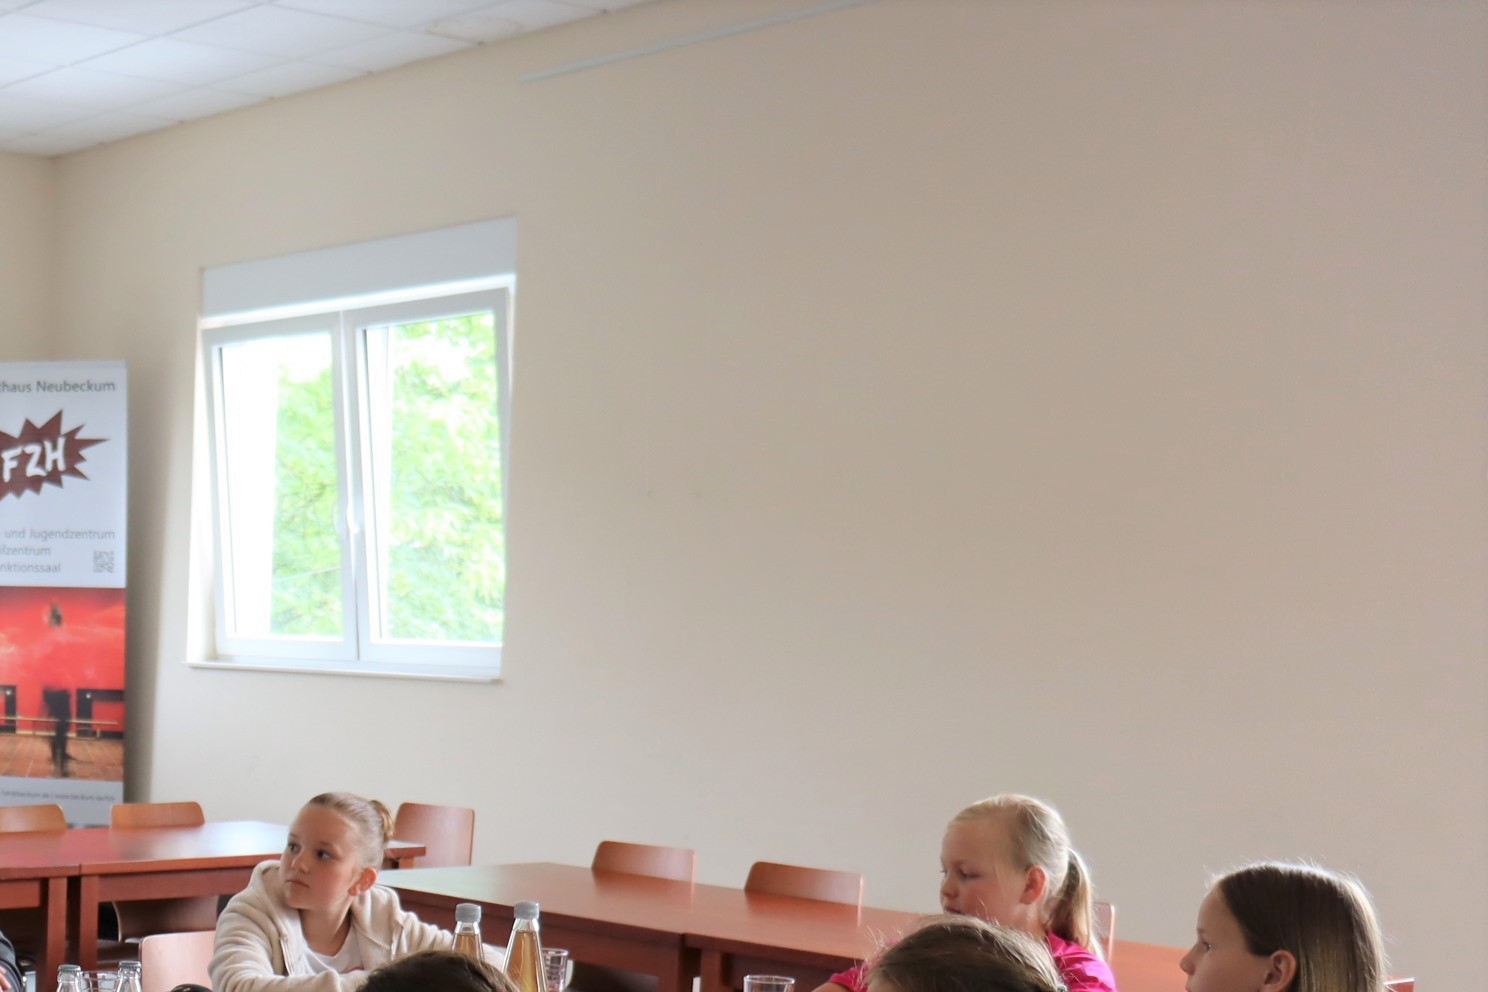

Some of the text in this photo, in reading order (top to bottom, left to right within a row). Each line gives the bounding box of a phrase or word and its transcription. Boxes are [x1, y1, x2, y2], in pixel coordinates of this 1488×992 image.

[36, 380, 116, 393] Neubeckum
[1, 437, 66, 483] FZH
[4, 528, 26, 540] und
[29, 528, 116, 542] Jugendzentrum
